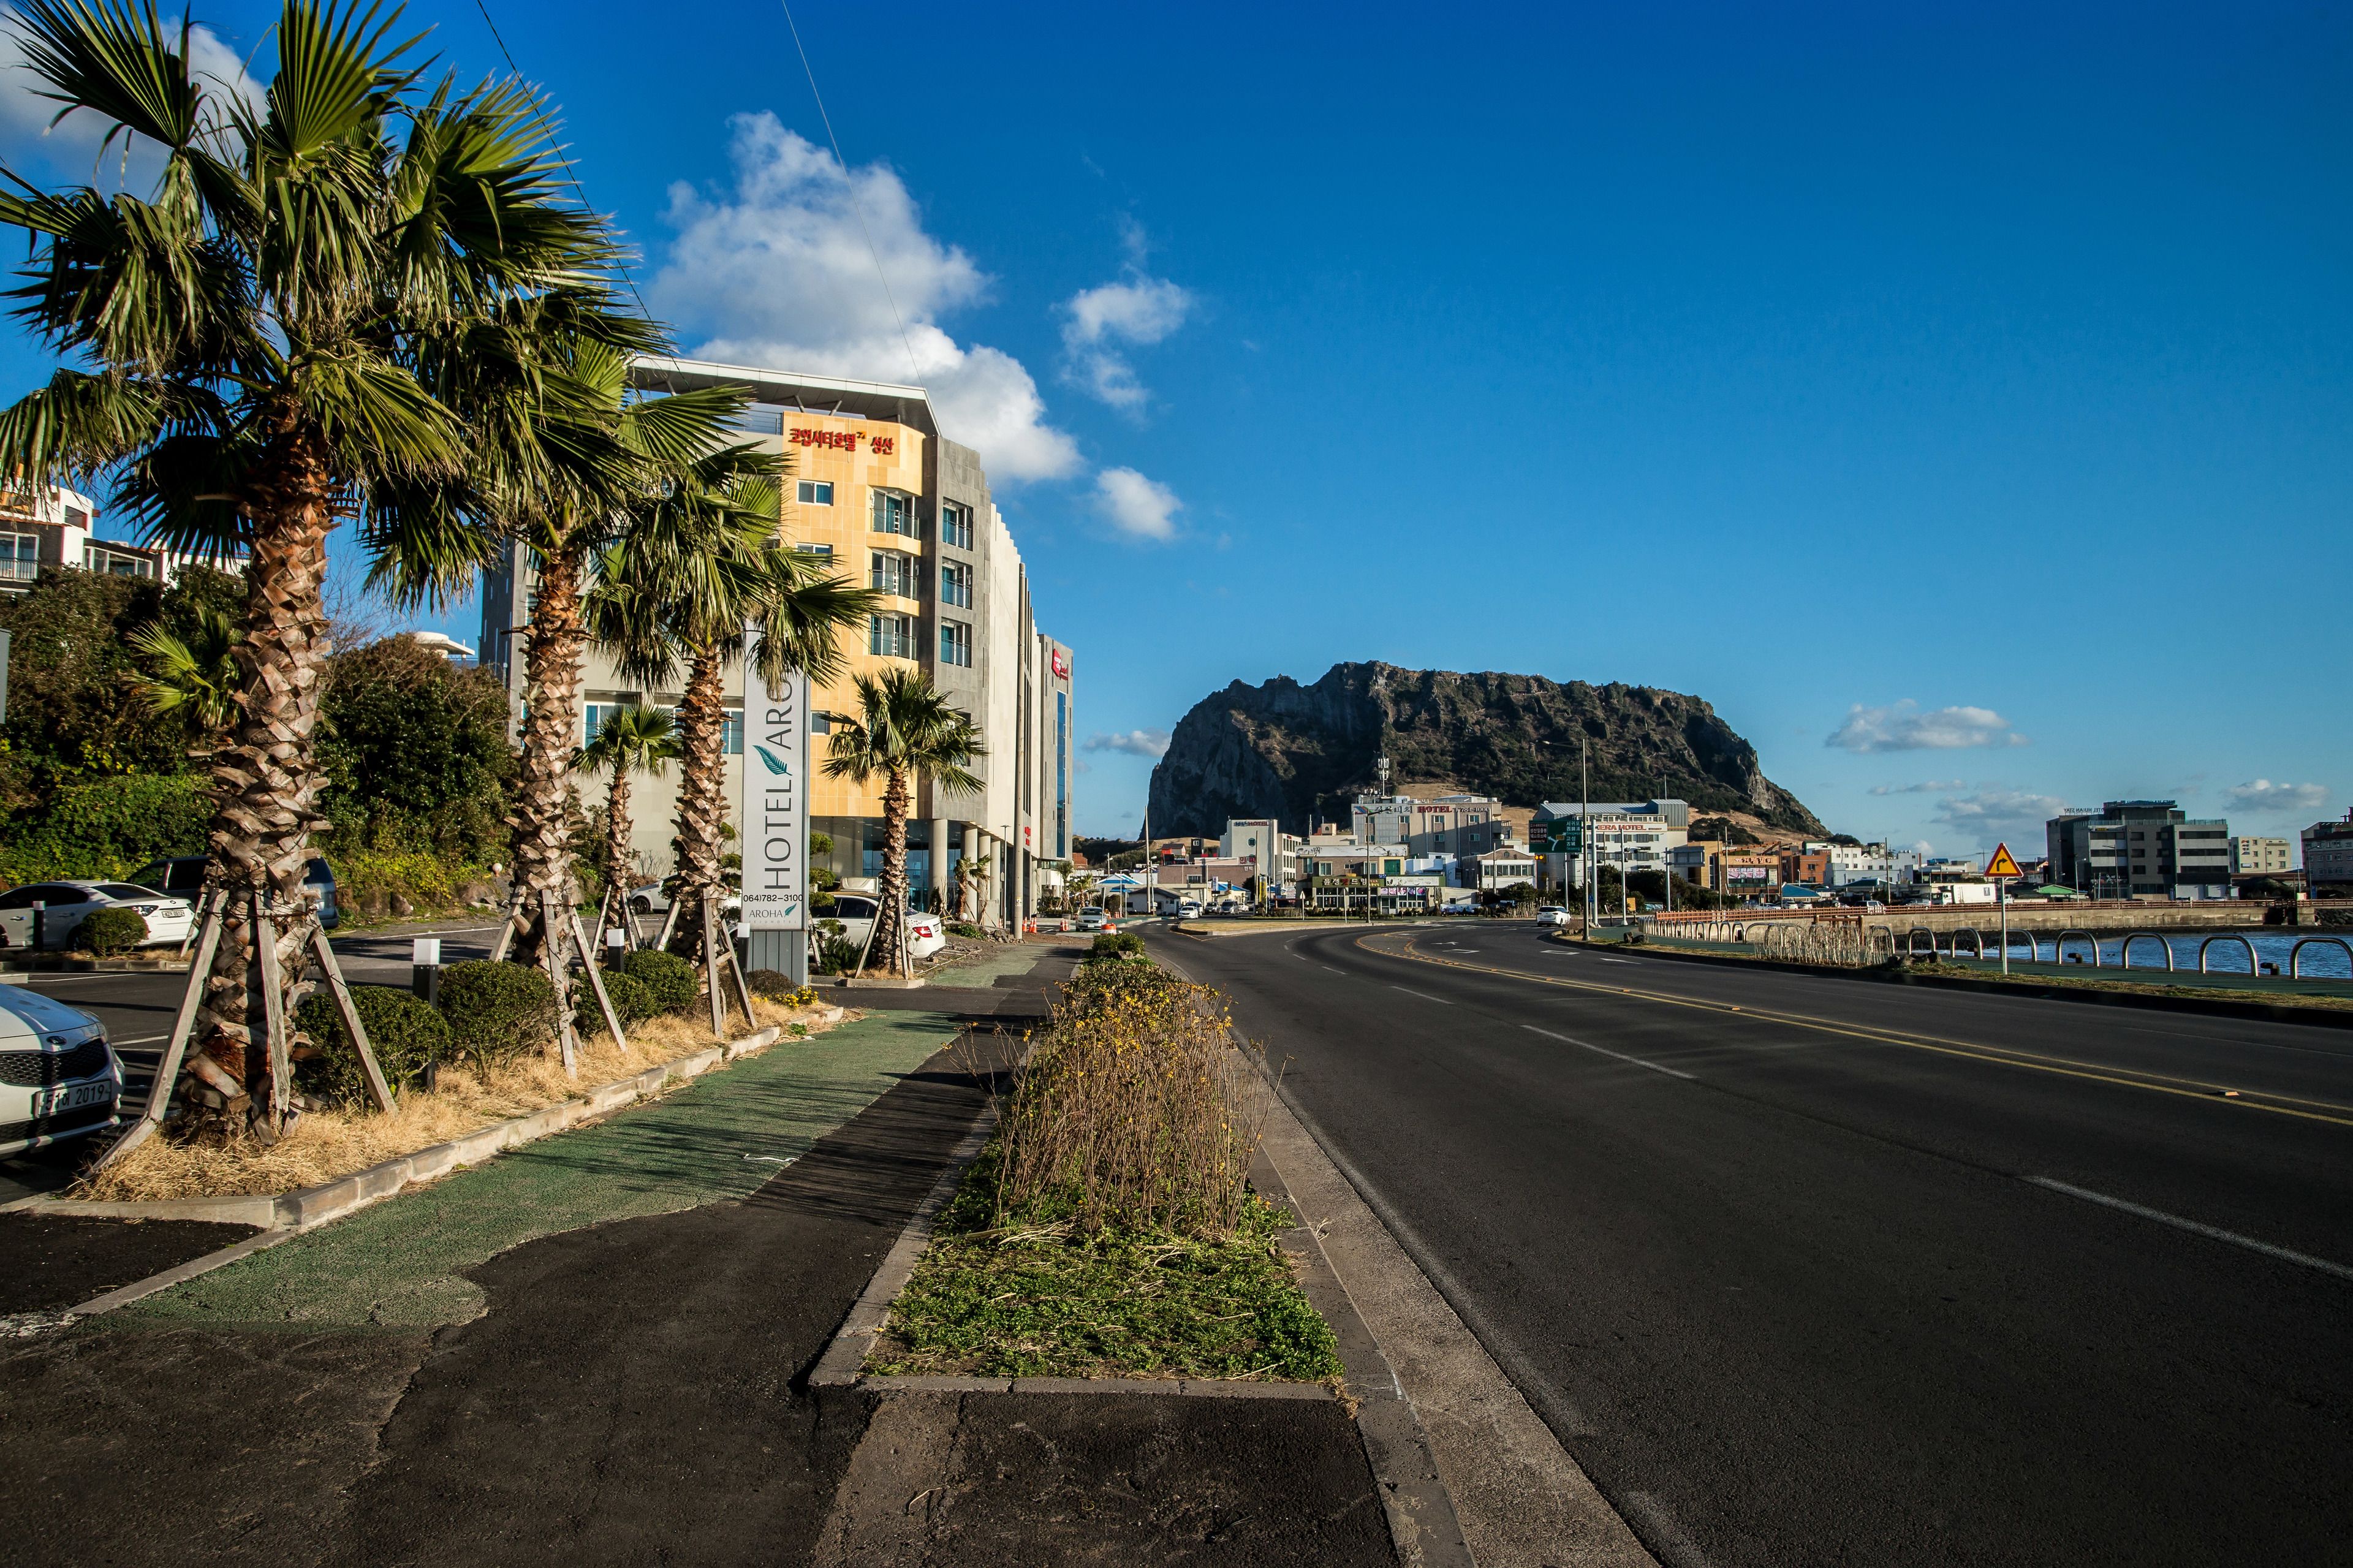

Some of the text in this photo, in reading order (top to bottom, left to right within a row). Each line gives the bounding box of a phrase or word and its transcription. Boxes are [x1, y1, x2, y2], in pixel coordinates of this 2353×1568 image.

[789, 428, 895, 455] 코업시티호텔 성산
[764, 678, 793, 889] HOTEL ARO
[743, 894, 803, 903] 064)782-3100
[749, 909, 783, 918] AROHA
[75, 1084, 105, 1105] 2019
